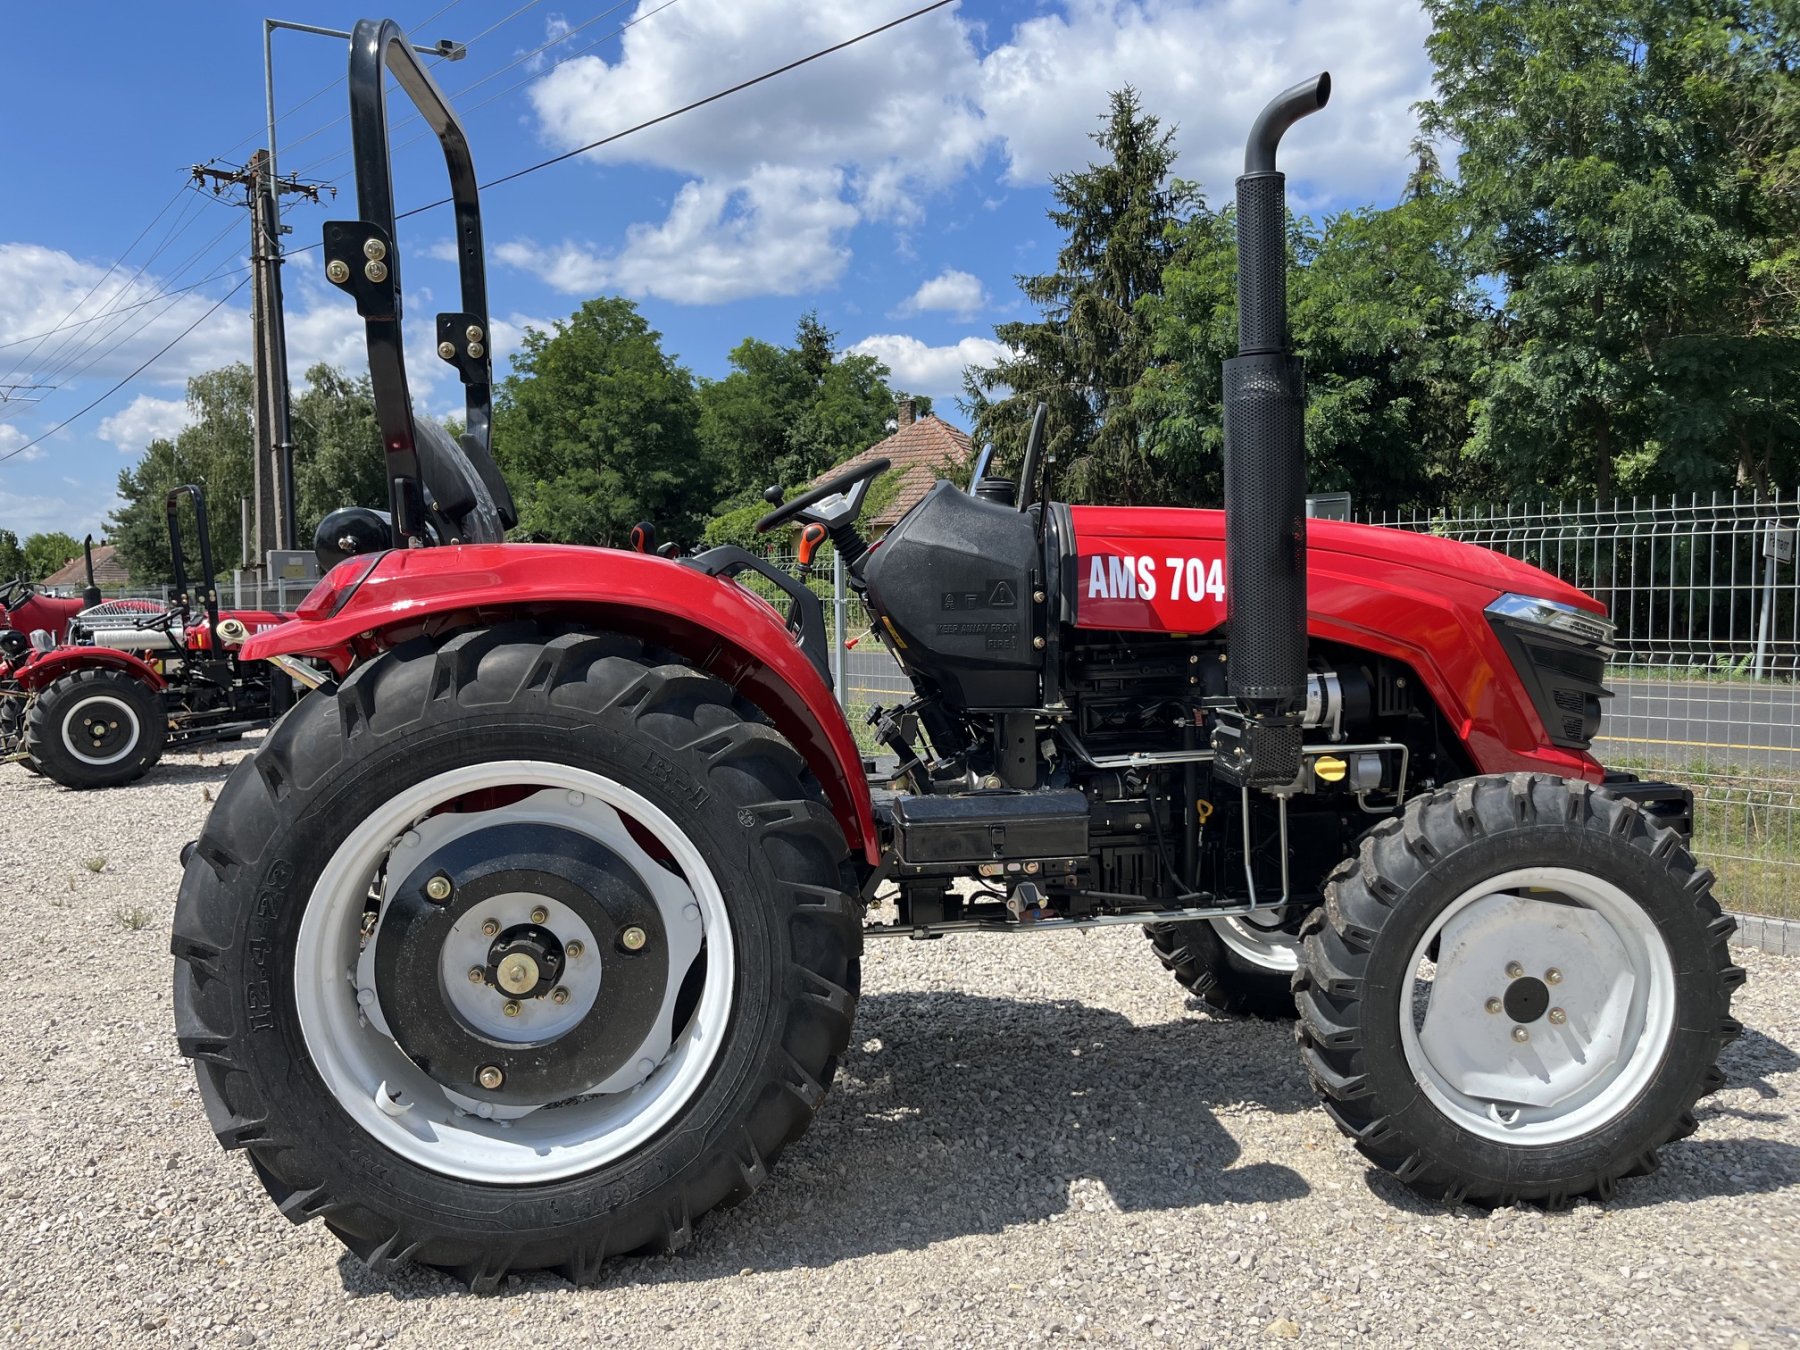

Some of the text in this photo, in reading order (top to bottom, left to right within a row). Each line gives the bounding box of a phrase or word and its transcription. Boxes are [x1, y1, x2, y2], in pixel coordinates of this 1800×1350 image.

[1088, 555, 1226, 602] AMS 704
[937, 624, 1018, 633] KEEP AWAY FROM
